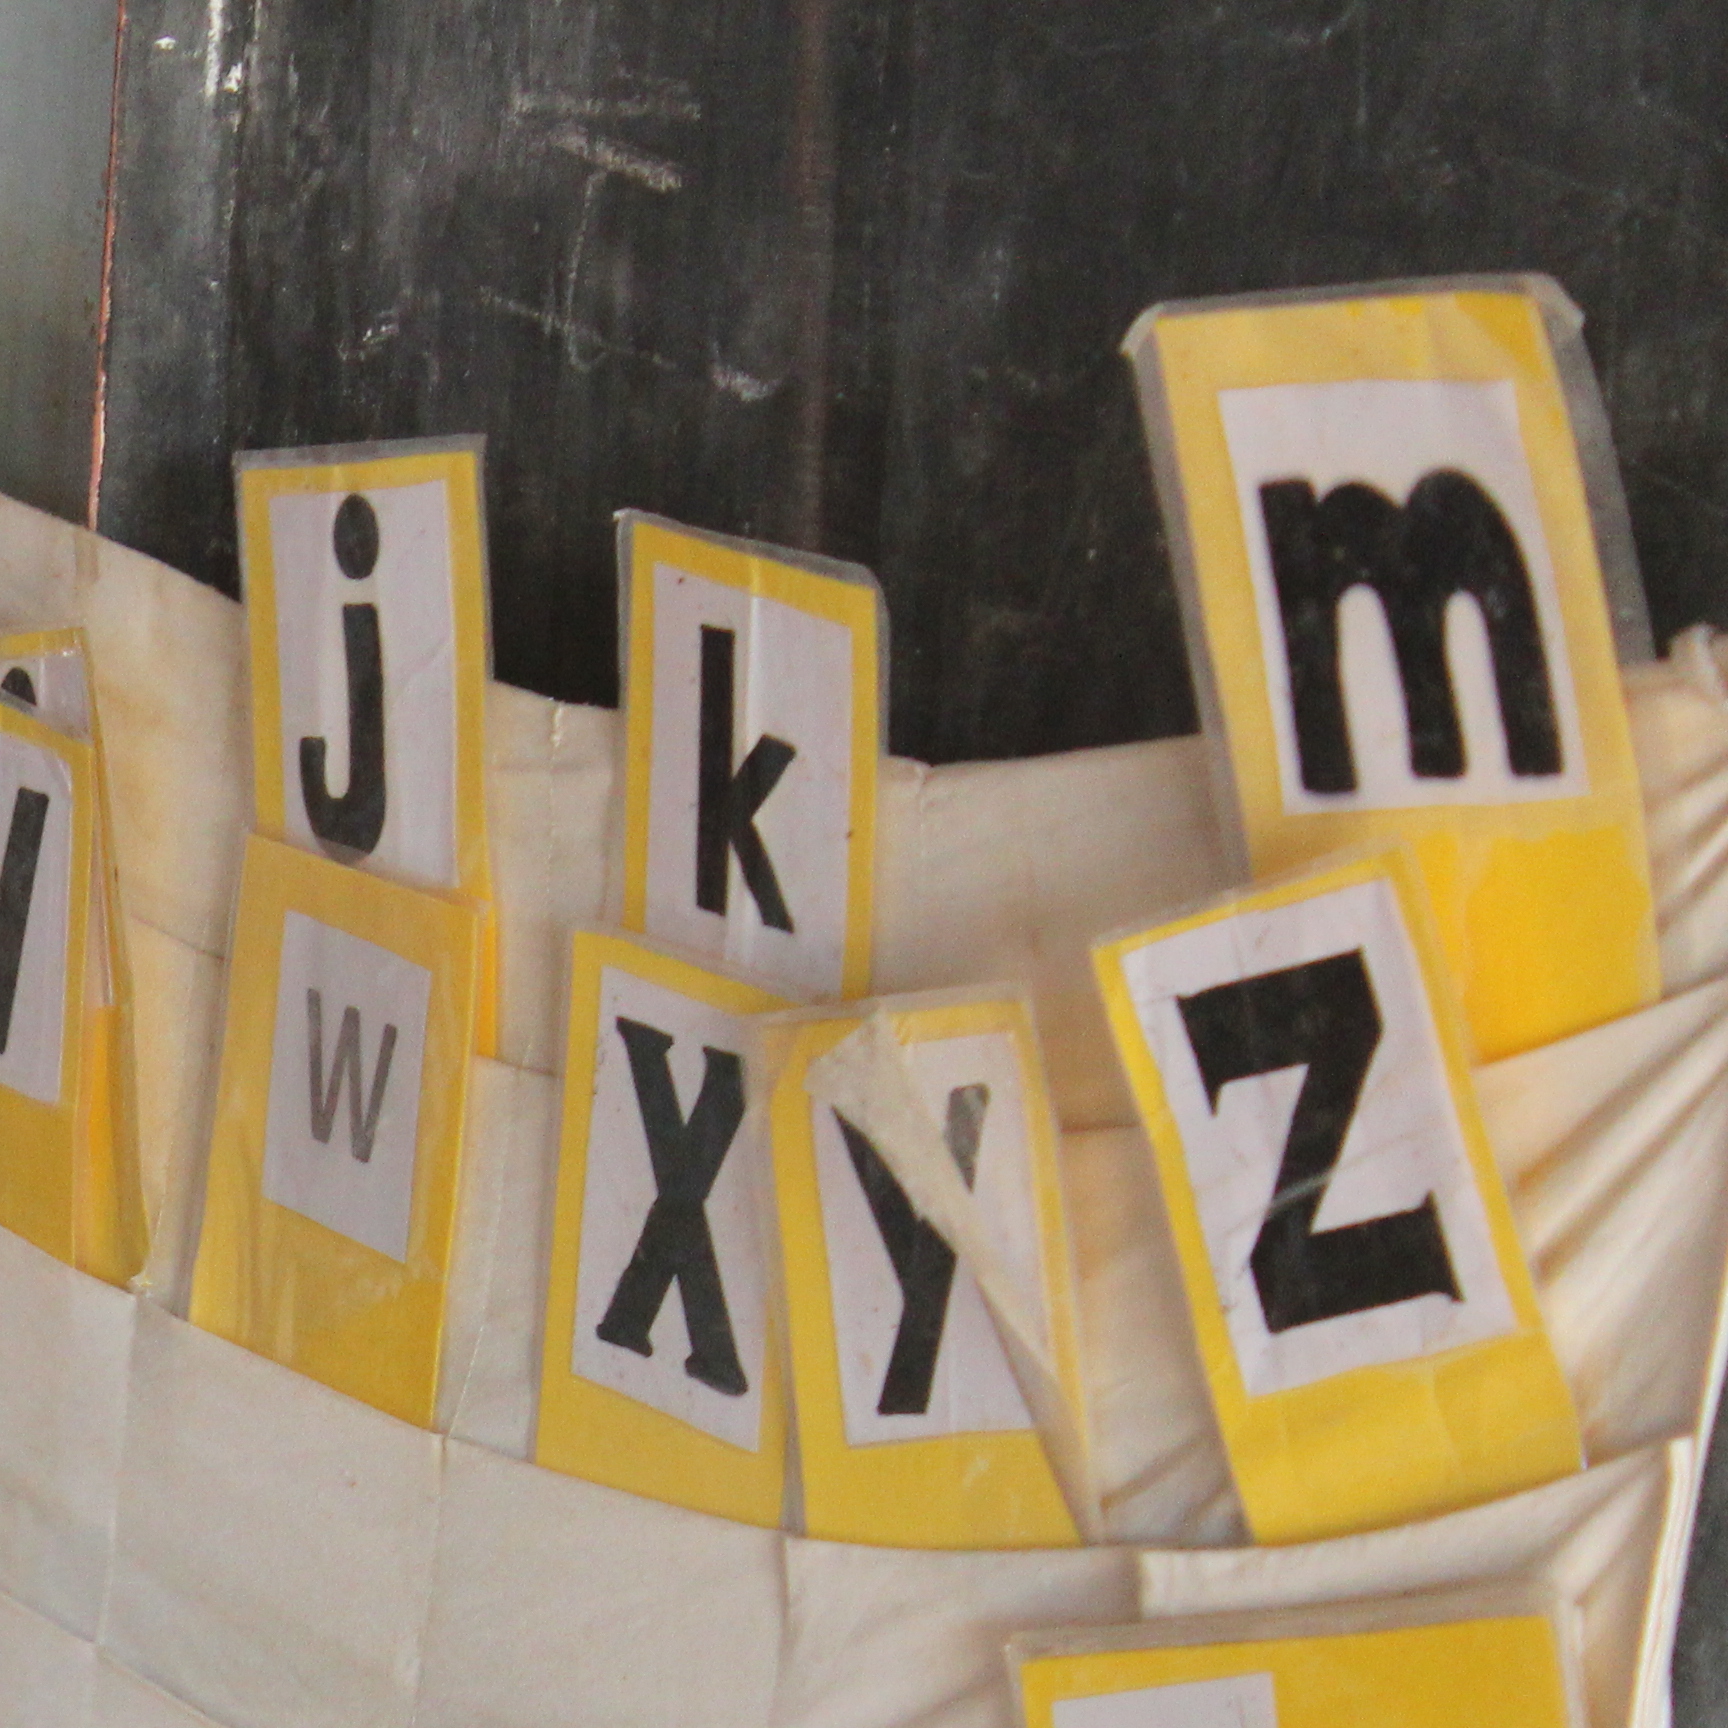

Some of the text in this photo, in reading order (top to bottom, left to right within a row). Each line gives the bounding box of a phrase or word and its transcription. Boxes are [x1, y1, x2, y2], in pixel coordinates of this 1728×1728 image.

[299, 493, 387, 867] j
[696, 623, 797, 934] k
[1257, 466, 1566, 796] m
